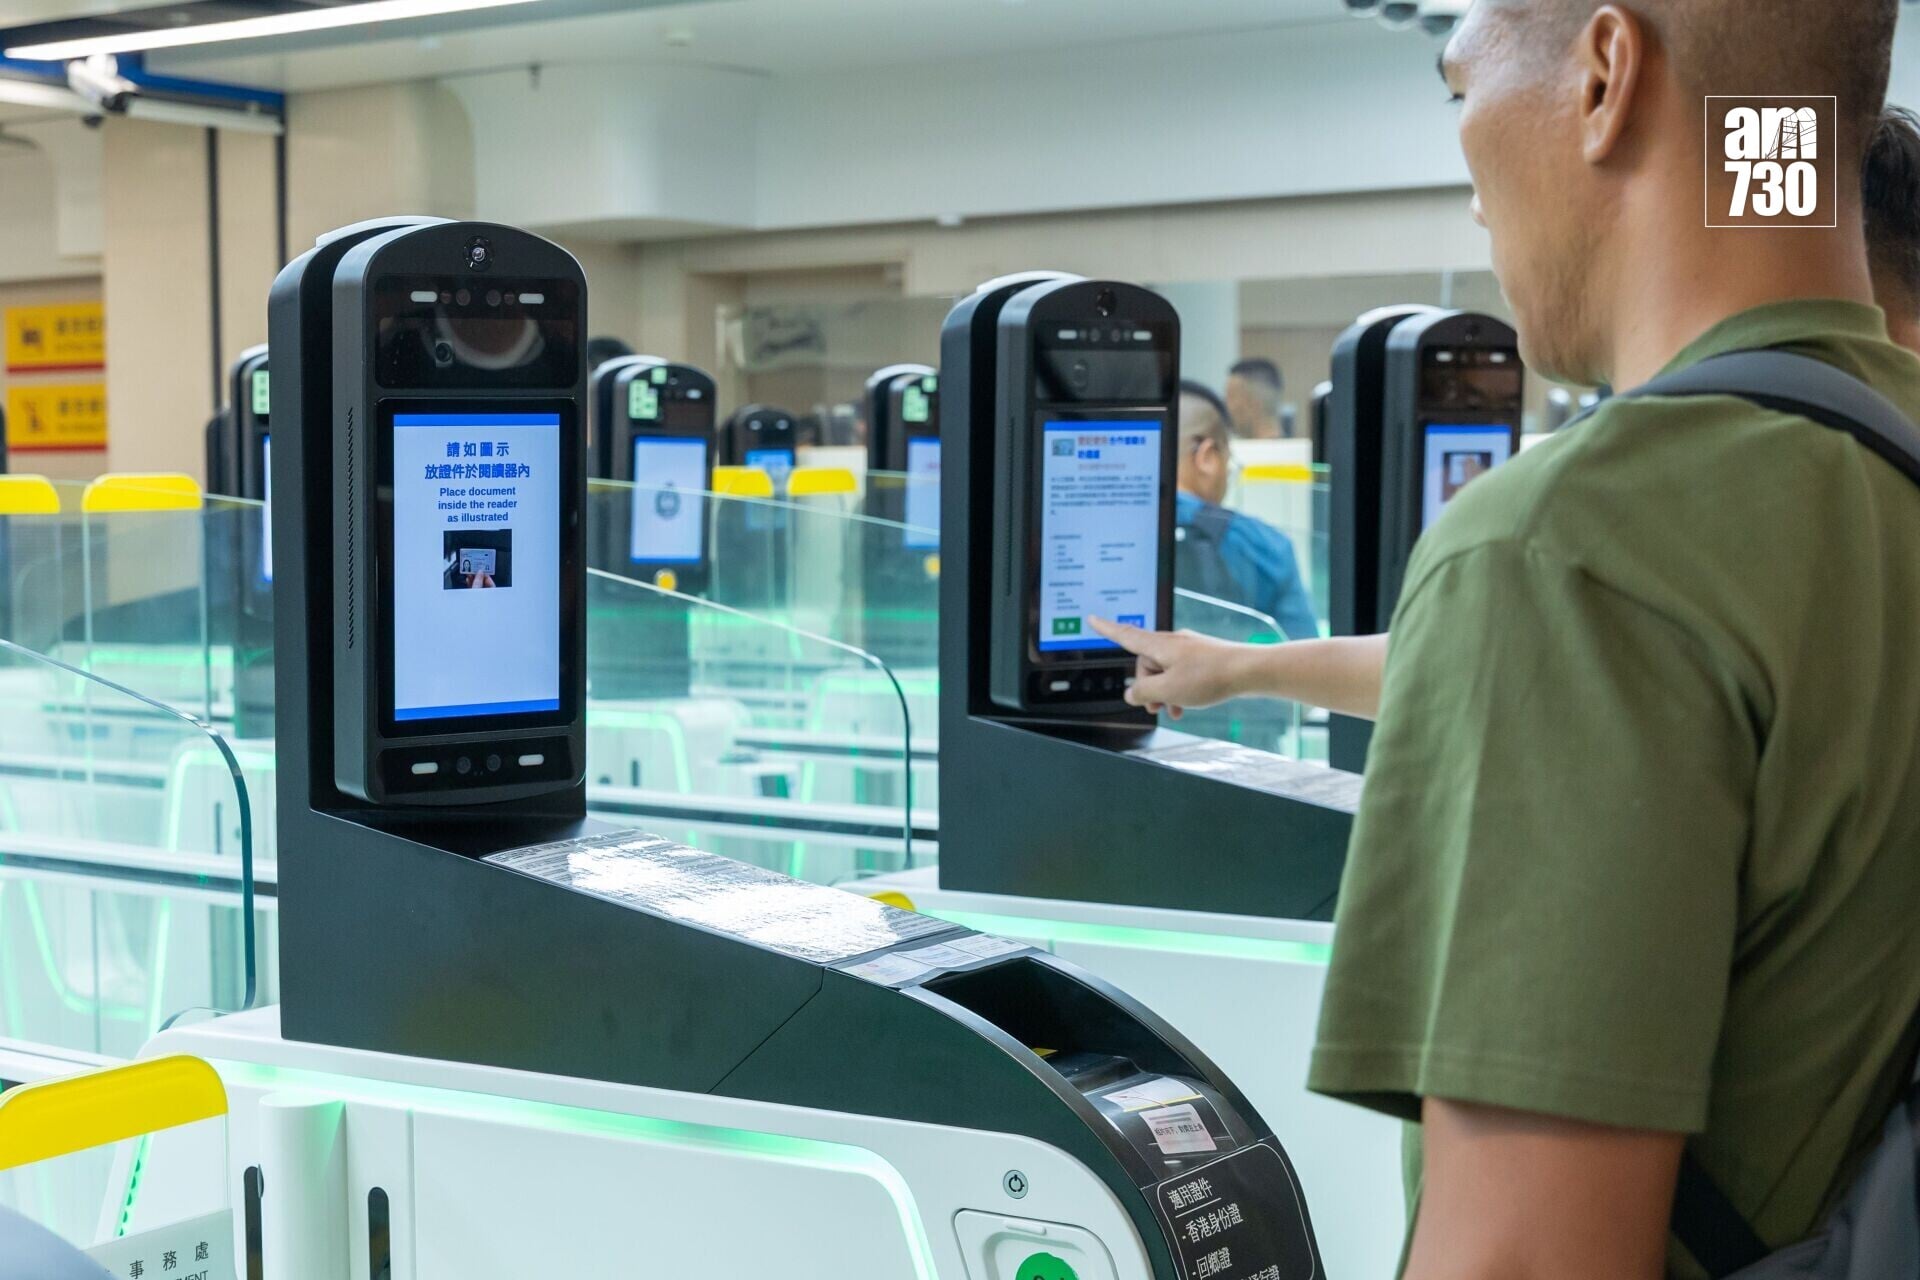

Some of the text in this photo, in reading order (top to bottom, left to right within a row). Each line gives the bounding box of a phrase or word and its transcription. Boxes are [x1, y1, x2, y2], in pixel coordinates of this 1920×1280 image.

[446, 442, 510, 457] 請如圖示
[440, 486, 516, 497] Place document
[438, 499, 518, 510] inside the reader
[447, 512, 509, 523] as illustrated
[1167, 1177, 1213, 1211] 適用證件
